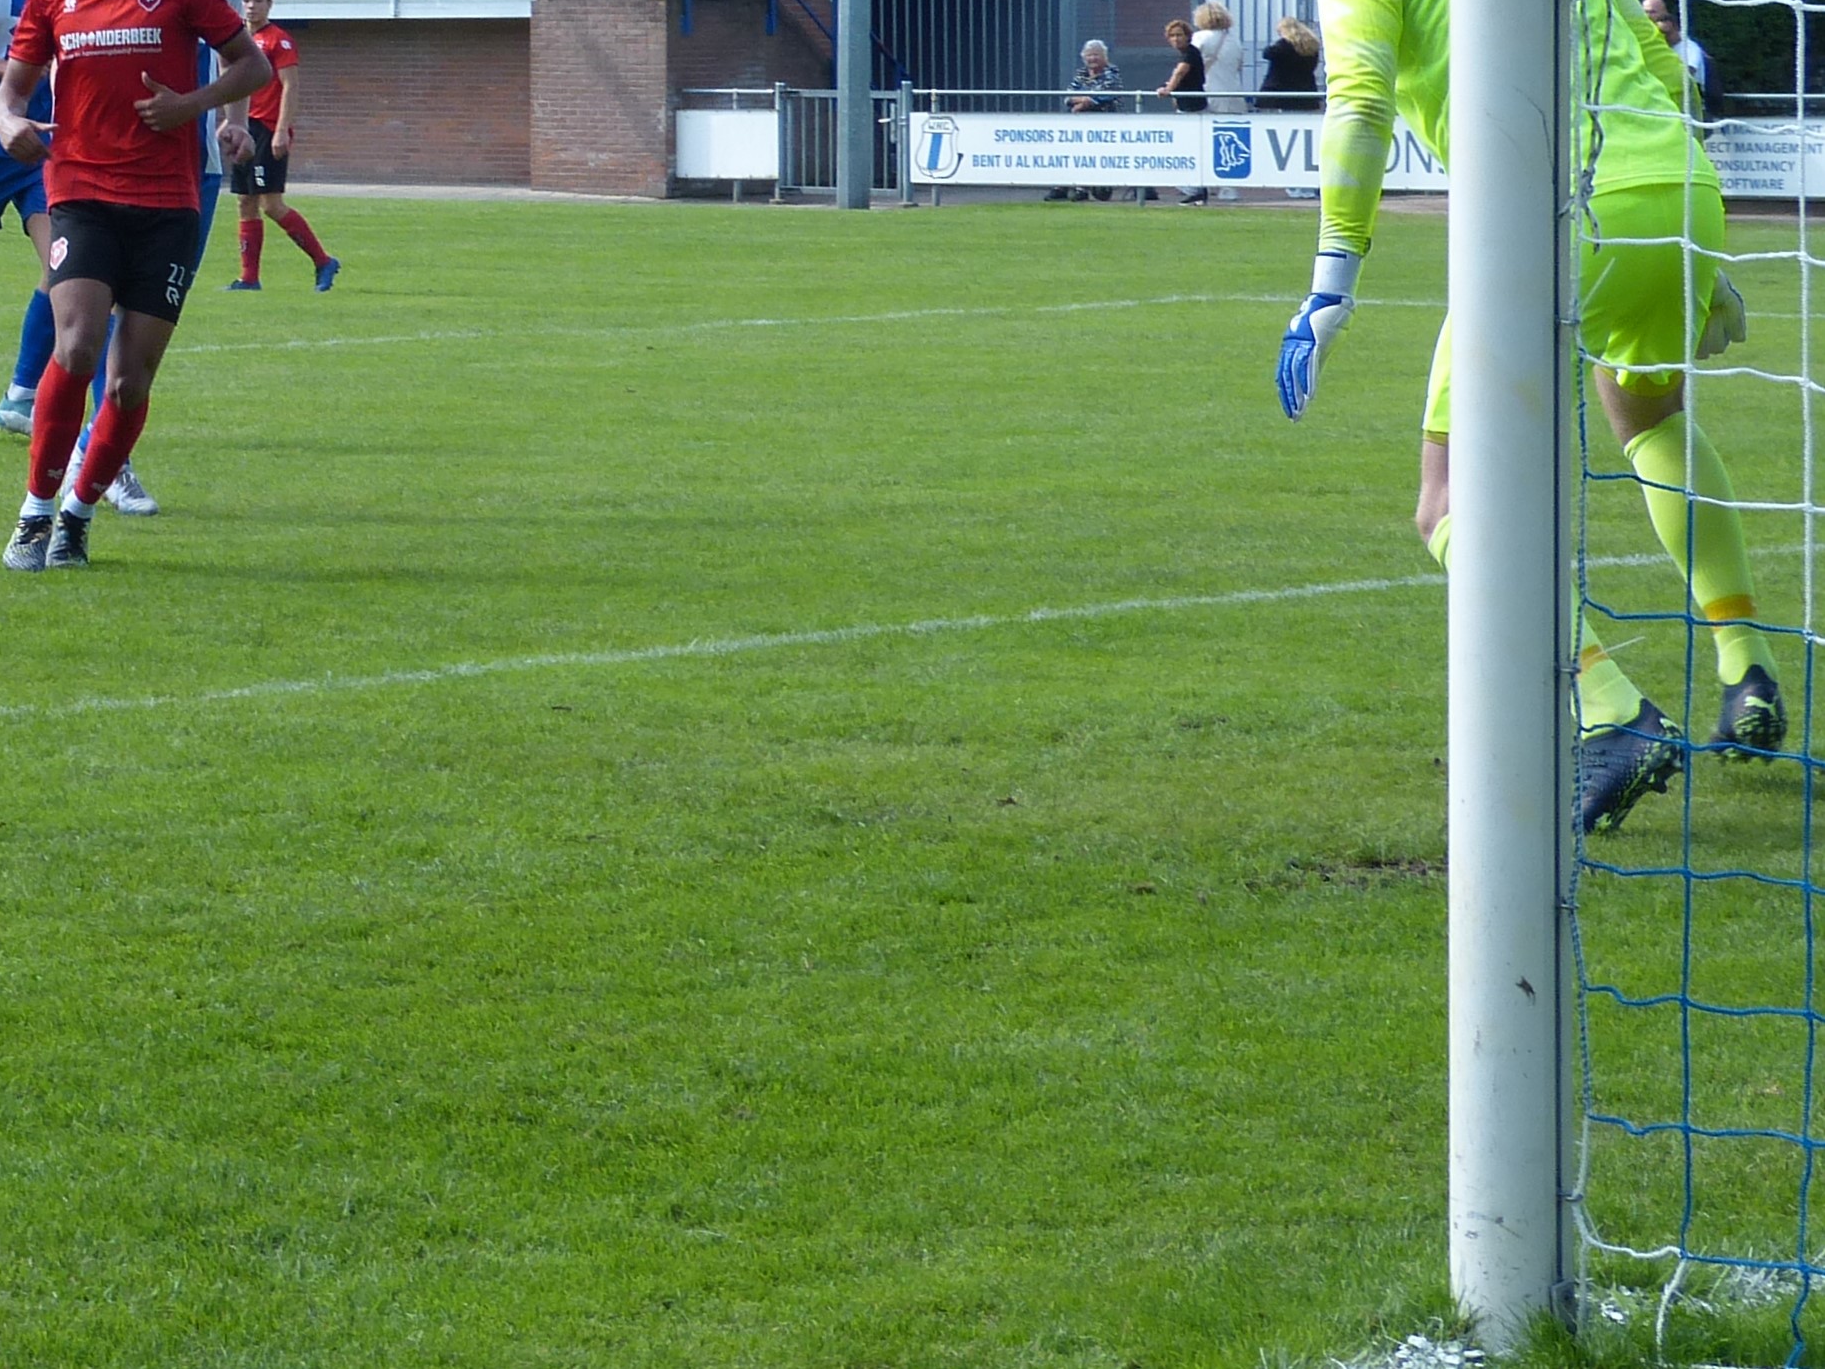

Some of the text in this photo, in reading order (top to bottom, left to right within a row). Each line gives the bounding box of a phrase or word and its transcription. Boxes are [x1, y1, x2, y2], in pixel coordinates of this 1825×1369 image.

[994, 129, 1174, 144] SPONSORS ZIJN ONZE KLANTEN
[972, 154, 1196, 170] BENT U AL KLANT VAN ONZE SPONSORS
